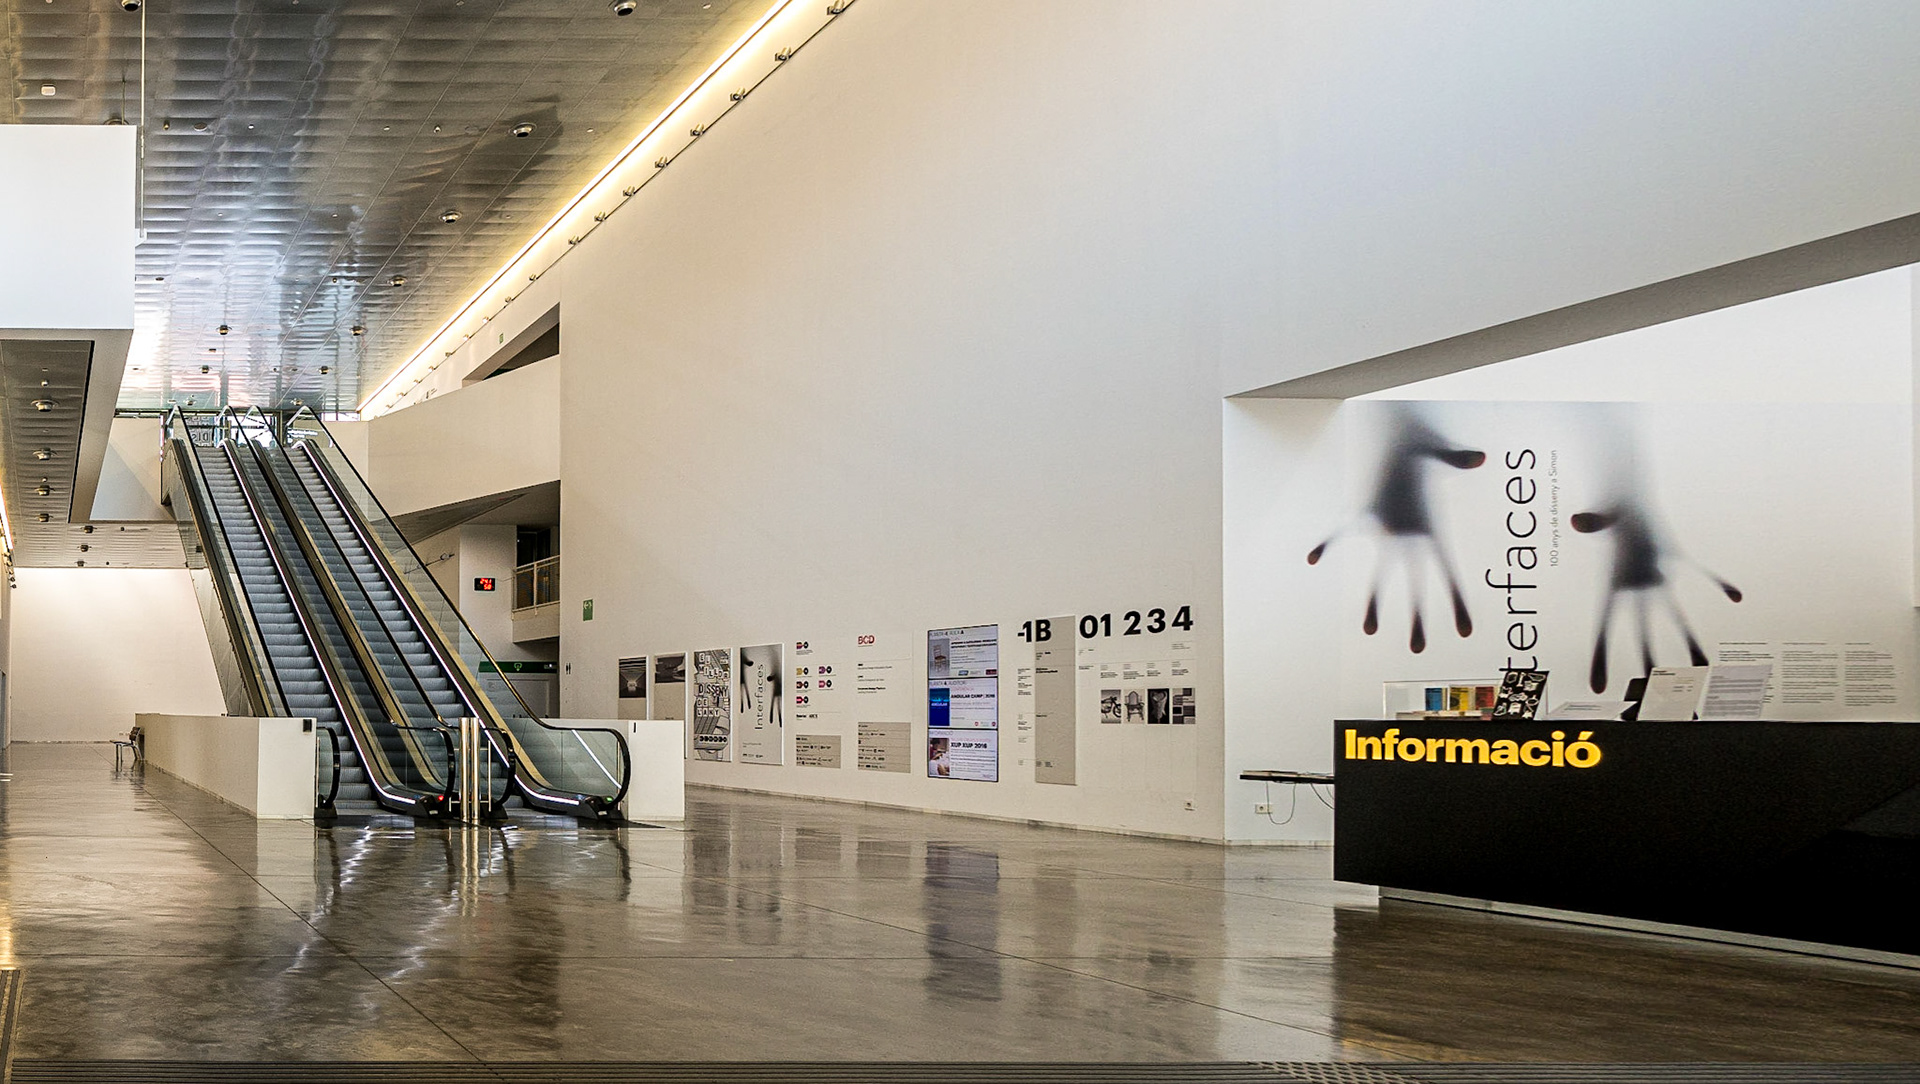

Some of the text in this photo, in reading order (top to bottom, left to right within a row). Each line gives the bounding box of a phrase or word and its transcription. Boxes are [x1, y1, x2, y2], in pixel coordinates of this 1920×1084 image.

[1548, 449, 1558, 477] Simon
[1549, 484, 1561, 515] disseny
[1549, 517, 1559, 528] de
[1551, 529, 1562, 548] anys
[1485, 449, 1538, 672] terfaces
[1549, 549, 1559, 567] 100
[858, 635, 875, 645] BCD
[754, 664, 763, 729] Interfaces
[1344, 728, 1601, 768] Informació
